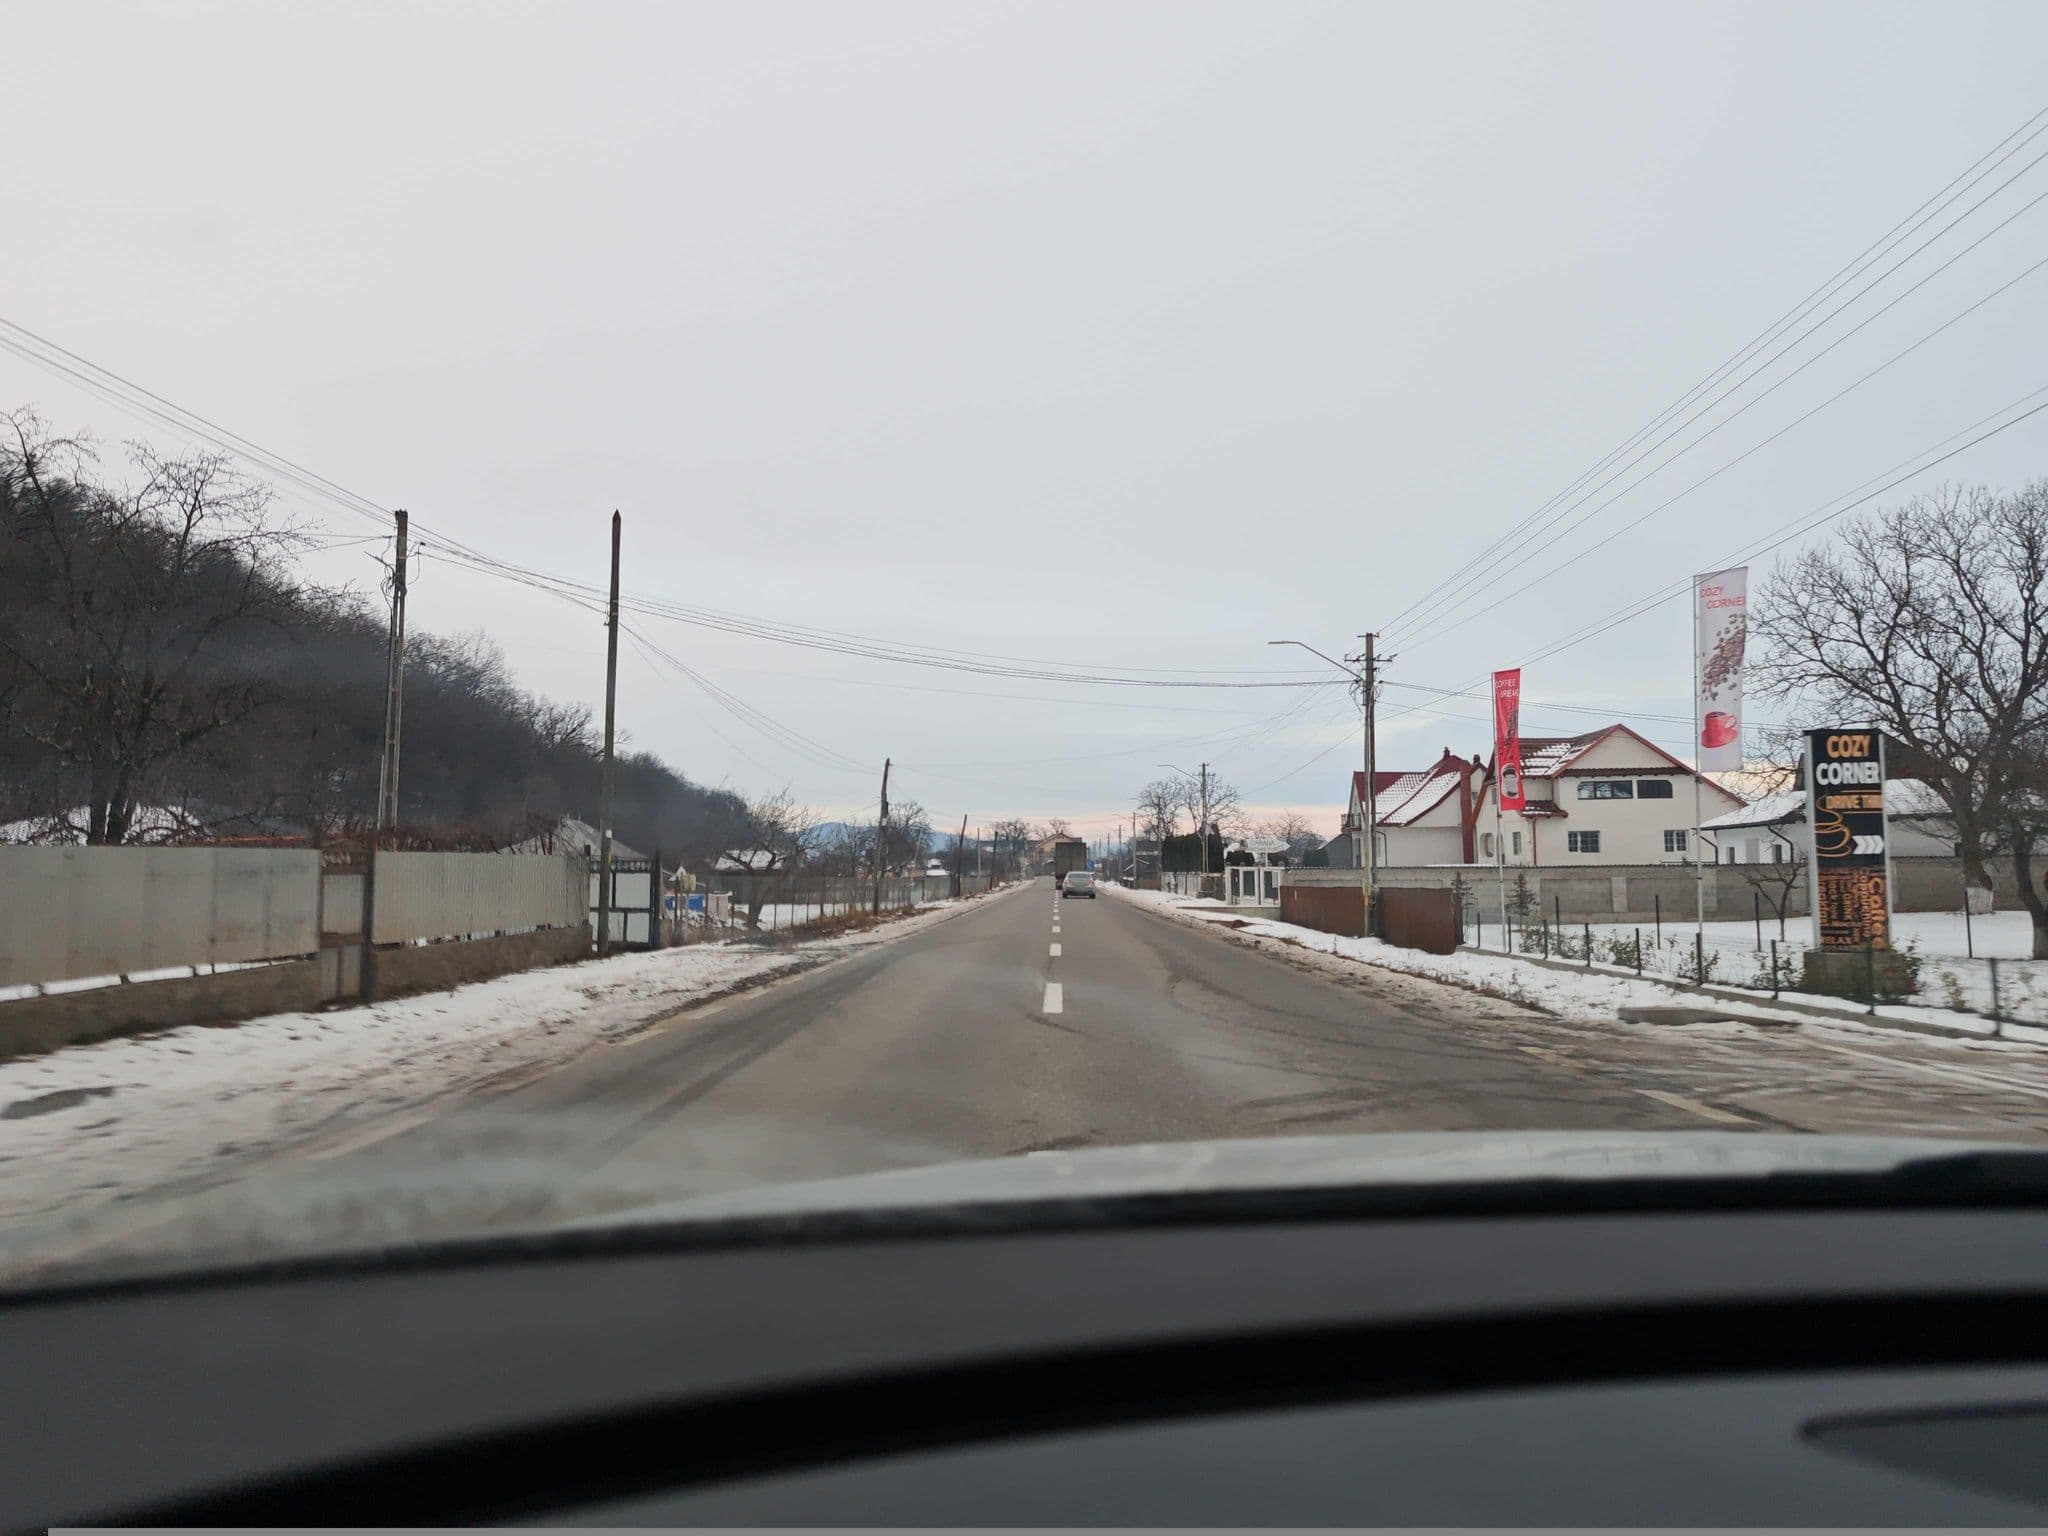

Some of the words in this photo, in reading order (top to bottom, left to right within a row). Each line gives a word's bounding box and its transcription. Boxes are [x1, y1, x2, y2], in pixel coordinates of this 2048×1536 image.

[1700, 584, 1726, 597] COZY
[1495, 679, 1515, 688] COFFEE
[1827, 735, 1870, 758] COZY
[1816, 762, 1880, 785] CORNER
[1826, 795, 1861, 809] DRIVE
